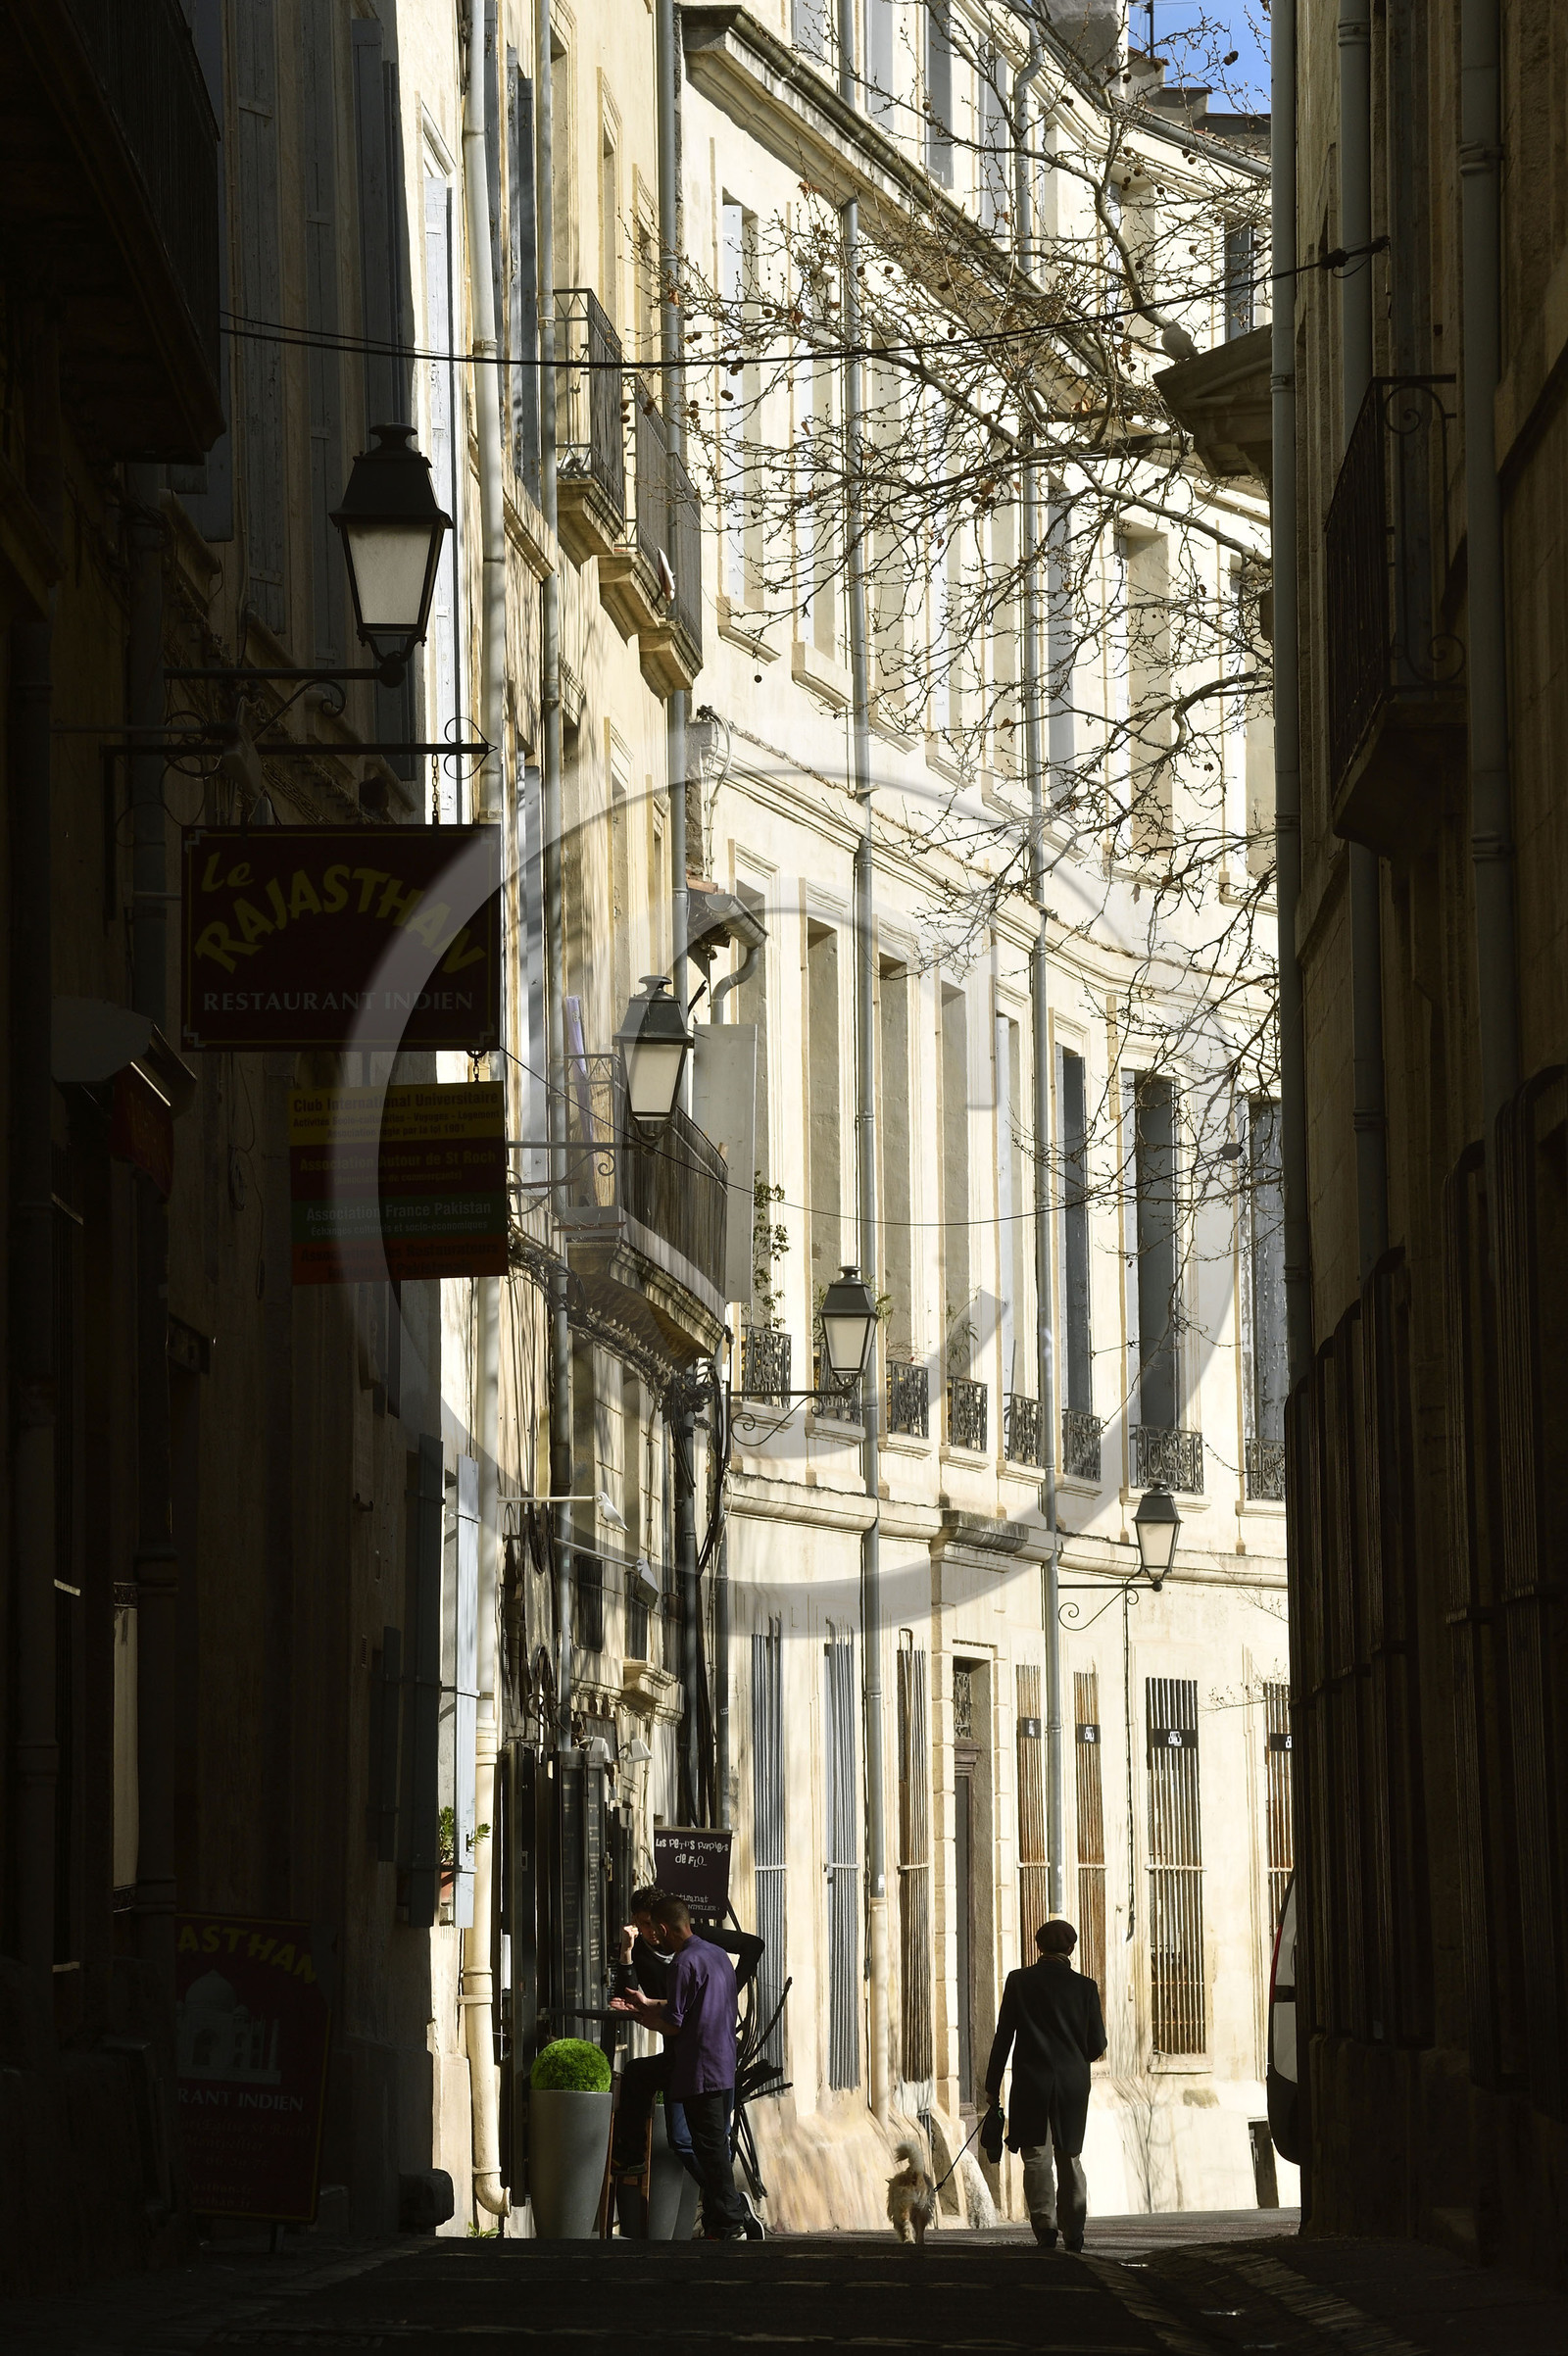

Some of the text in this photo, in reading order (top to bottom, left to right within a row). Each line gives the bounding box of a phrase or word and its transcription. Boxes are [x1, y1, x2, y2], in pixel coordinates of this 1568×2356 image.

[201, 851, 255, 893] Le
[194, 863, 487, 975] RAJASTHAN
[203, 991, 473, 1011] RESTAURANT INDIEN
[294, 1091, 498, 1112] Club International Universitaire
[403, 1125, 417, 1137] par
[419, 1125, 428, 1134] la
[430, 1124, 441, 1134] loi
[444, 1123, 465, 1133] 1901
[300, 1150, 496, 1172] Association Autour de St Roch
[306, 1200, 491, 1222] Association France Pakistan
[674, 1853, 686, 1864] de
[176, 1924, 318, 1985] ASTHAN
[177, 2087, 305, 2113] RANT INDIEN
